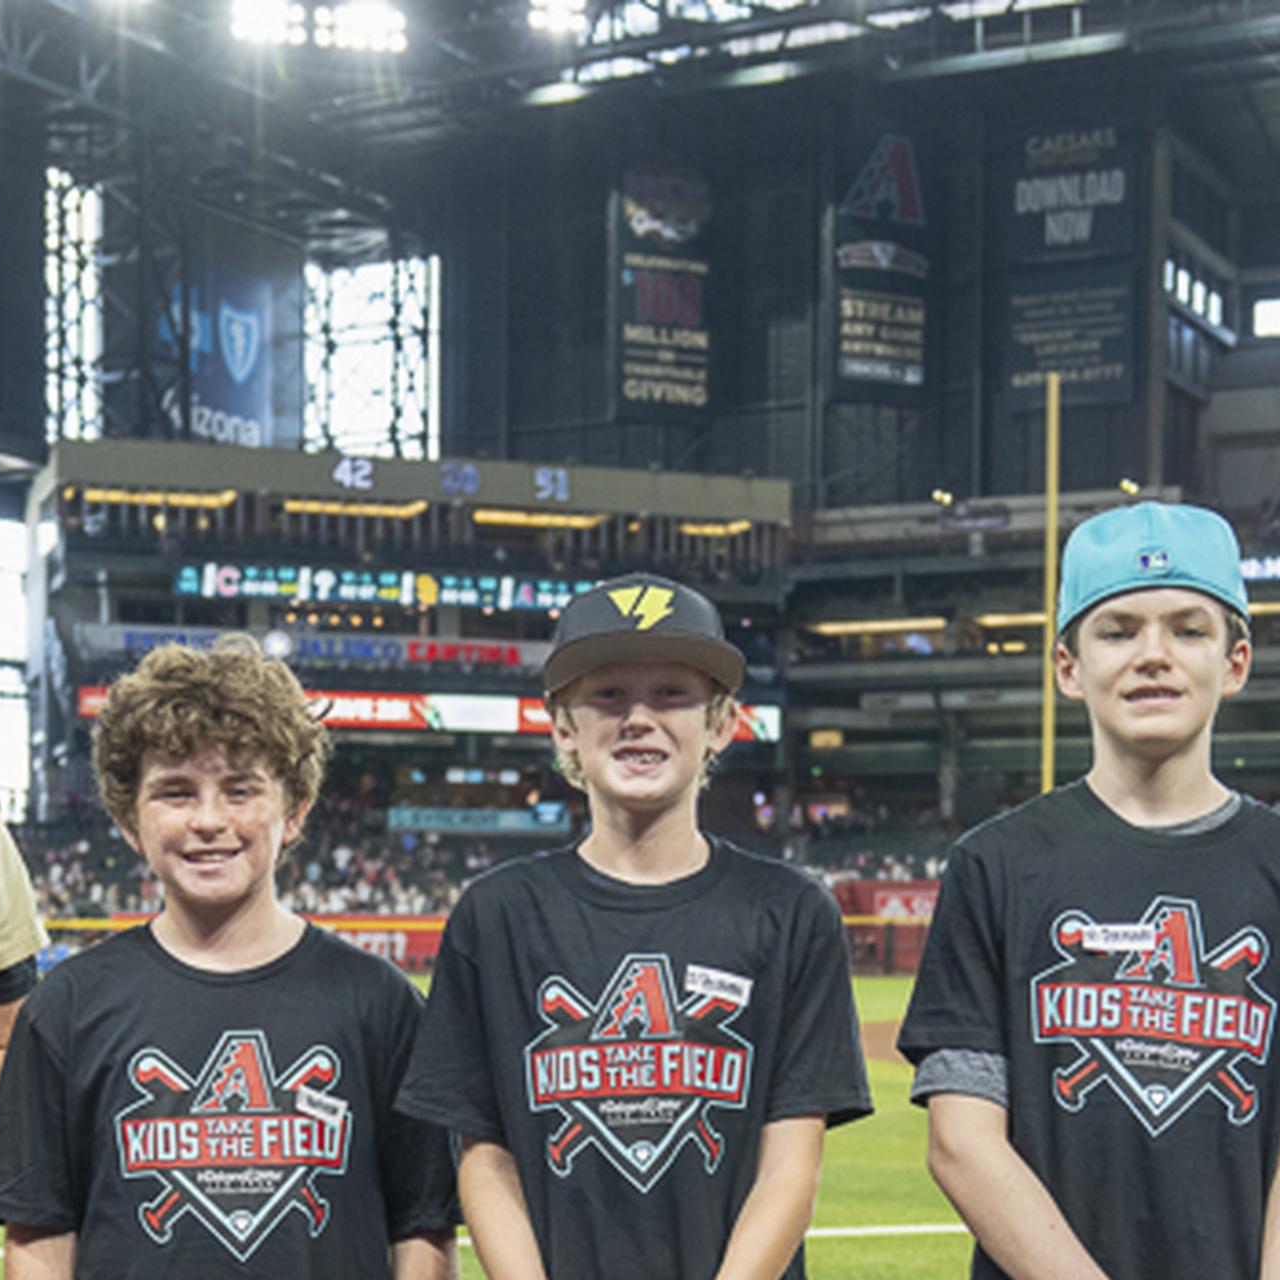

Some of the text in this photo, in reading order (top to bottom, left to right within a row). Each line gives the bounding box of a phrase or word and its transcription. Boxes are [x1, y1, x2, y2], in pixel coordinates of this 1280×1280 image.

[1015, 169, 1124, 213] DOWNLOAD
[1045, 210, 1094, 245] NOW
[624, 324, 708, 348] MILLION
[624, 379, 707, 407] GIVING
[333, 457, 373, 489] 42
[535, 467, 568, 501] 51
[1043, 986, 1264, 1047] KIDS TAKE THE FIELD
[536, 1046, 742, 1094] KIDS TAKE THE FIELD
[126, 1120, 340, 1163] KIDS TAKE THE FIELD
